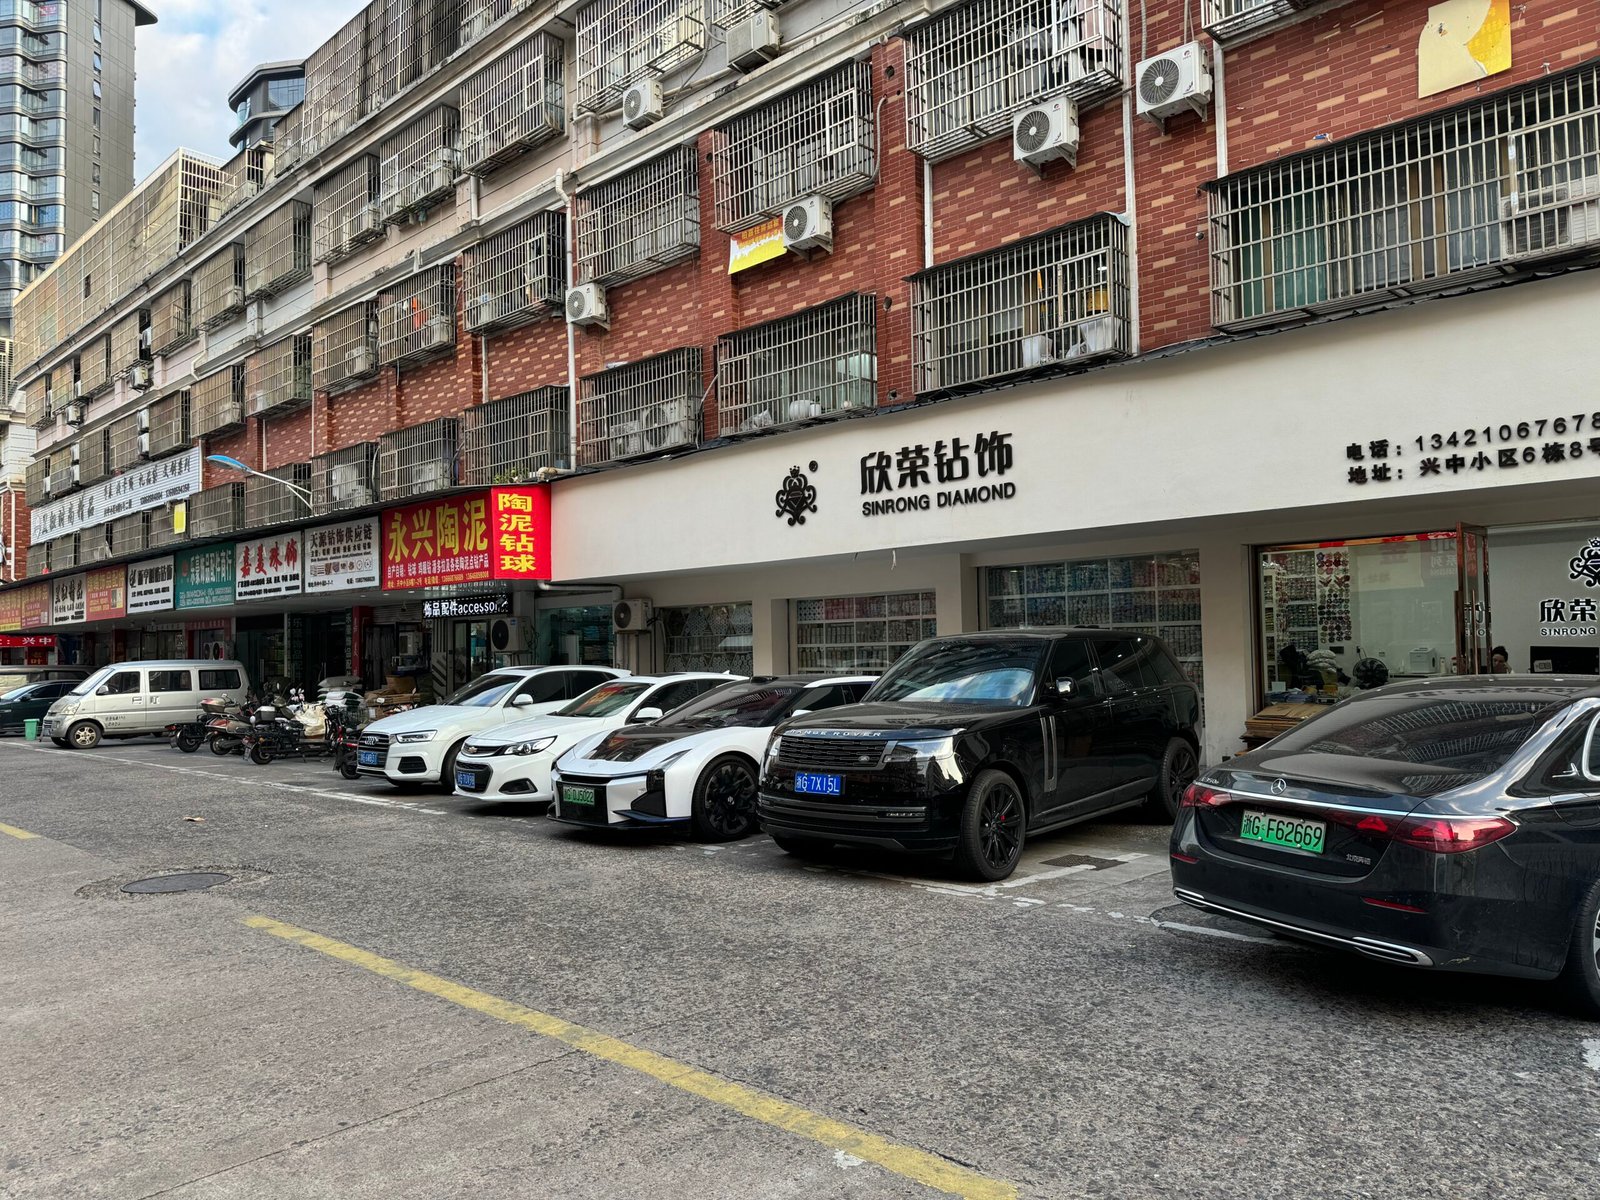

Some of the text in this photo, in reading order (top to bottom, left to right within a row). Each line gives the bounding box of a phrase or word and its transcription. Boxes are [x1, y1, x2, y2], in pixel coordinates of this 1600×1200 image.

[860, 431, 1013, 494] 欣荣钻饰
[862, 482, 1016, 516] SINRONG DIAMOND
[388, 499, 488, 563] 永兴陶泥
[498, 493, 536, 573] 陶泥钻球
[1540, 626, 1598, 637] SINRONG
